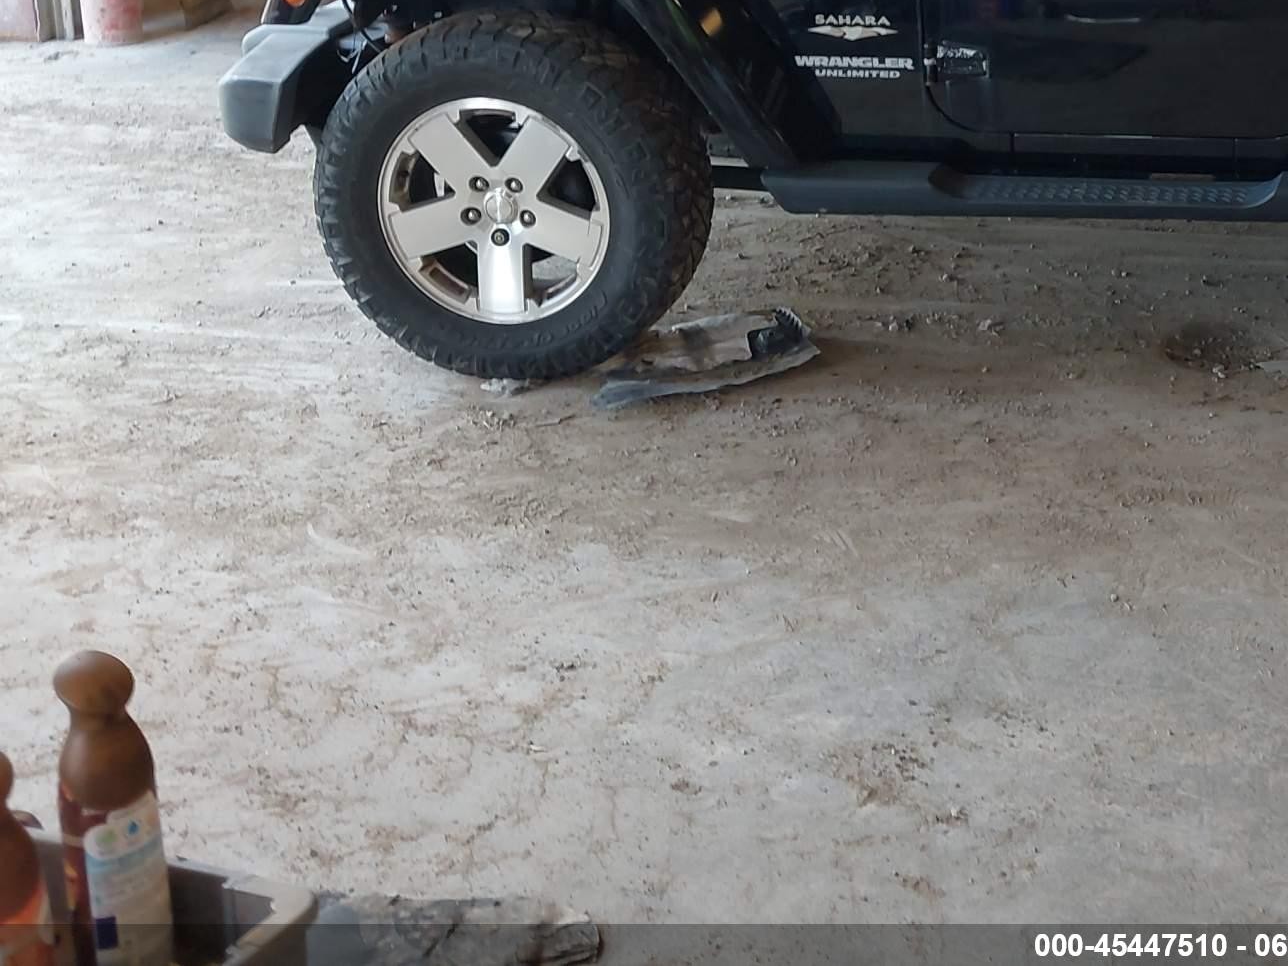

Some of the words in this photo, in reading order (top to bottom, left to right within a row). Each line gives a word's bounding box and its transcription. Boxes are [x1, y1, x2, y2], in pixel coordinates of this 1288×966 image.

[815, 14, 891, 26] SAHARA
[794, 55, 915, 70] WRANGLER
[815, 69, 901, 79] UNLIMITED
